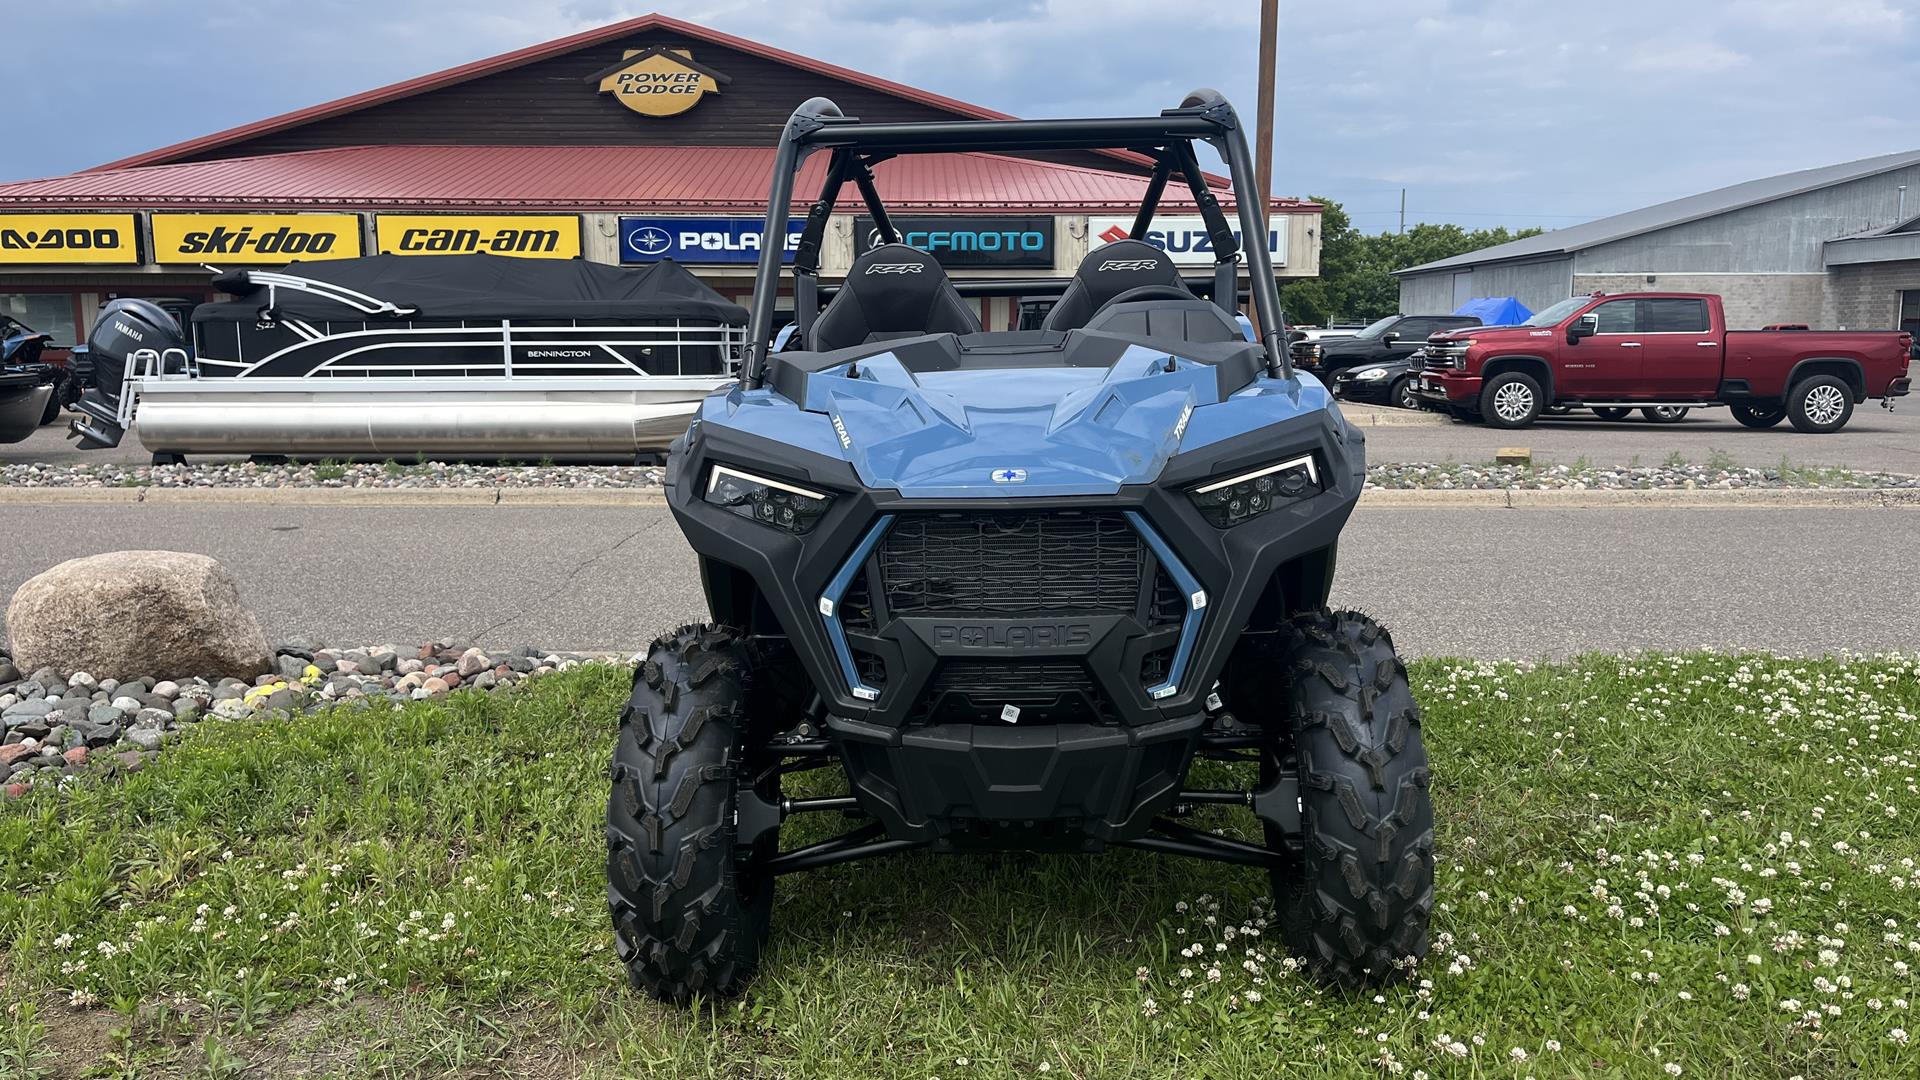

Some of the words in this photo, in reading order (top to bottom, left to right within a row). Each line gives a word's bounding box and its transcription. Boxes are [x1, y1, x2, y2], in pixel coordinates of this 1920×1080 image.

[617, 73, 700, 85] POWER
[622, 84, 698, 95] LODGE
[179, 227, 337, 253] ski-doo
[399, 229, 560, 251] can-am
[679, 232, 803, 250] POLAIS
[905, 231, 1044, 251] CFMOTO
[1142, 230, 1278, 252] SUZI
[866, 263, 924, 275] RZR
[1099, 259, 1158, 272] RZR
[114, 320, 144, 343] YAMAHA
[527, 350, 591, 358] BENNINGTON
[833, 414, 851, 449] TRAIL
[1173, 404, 1192, 441] TRAIL
[933, 624, 1093, 649] POLARIS
